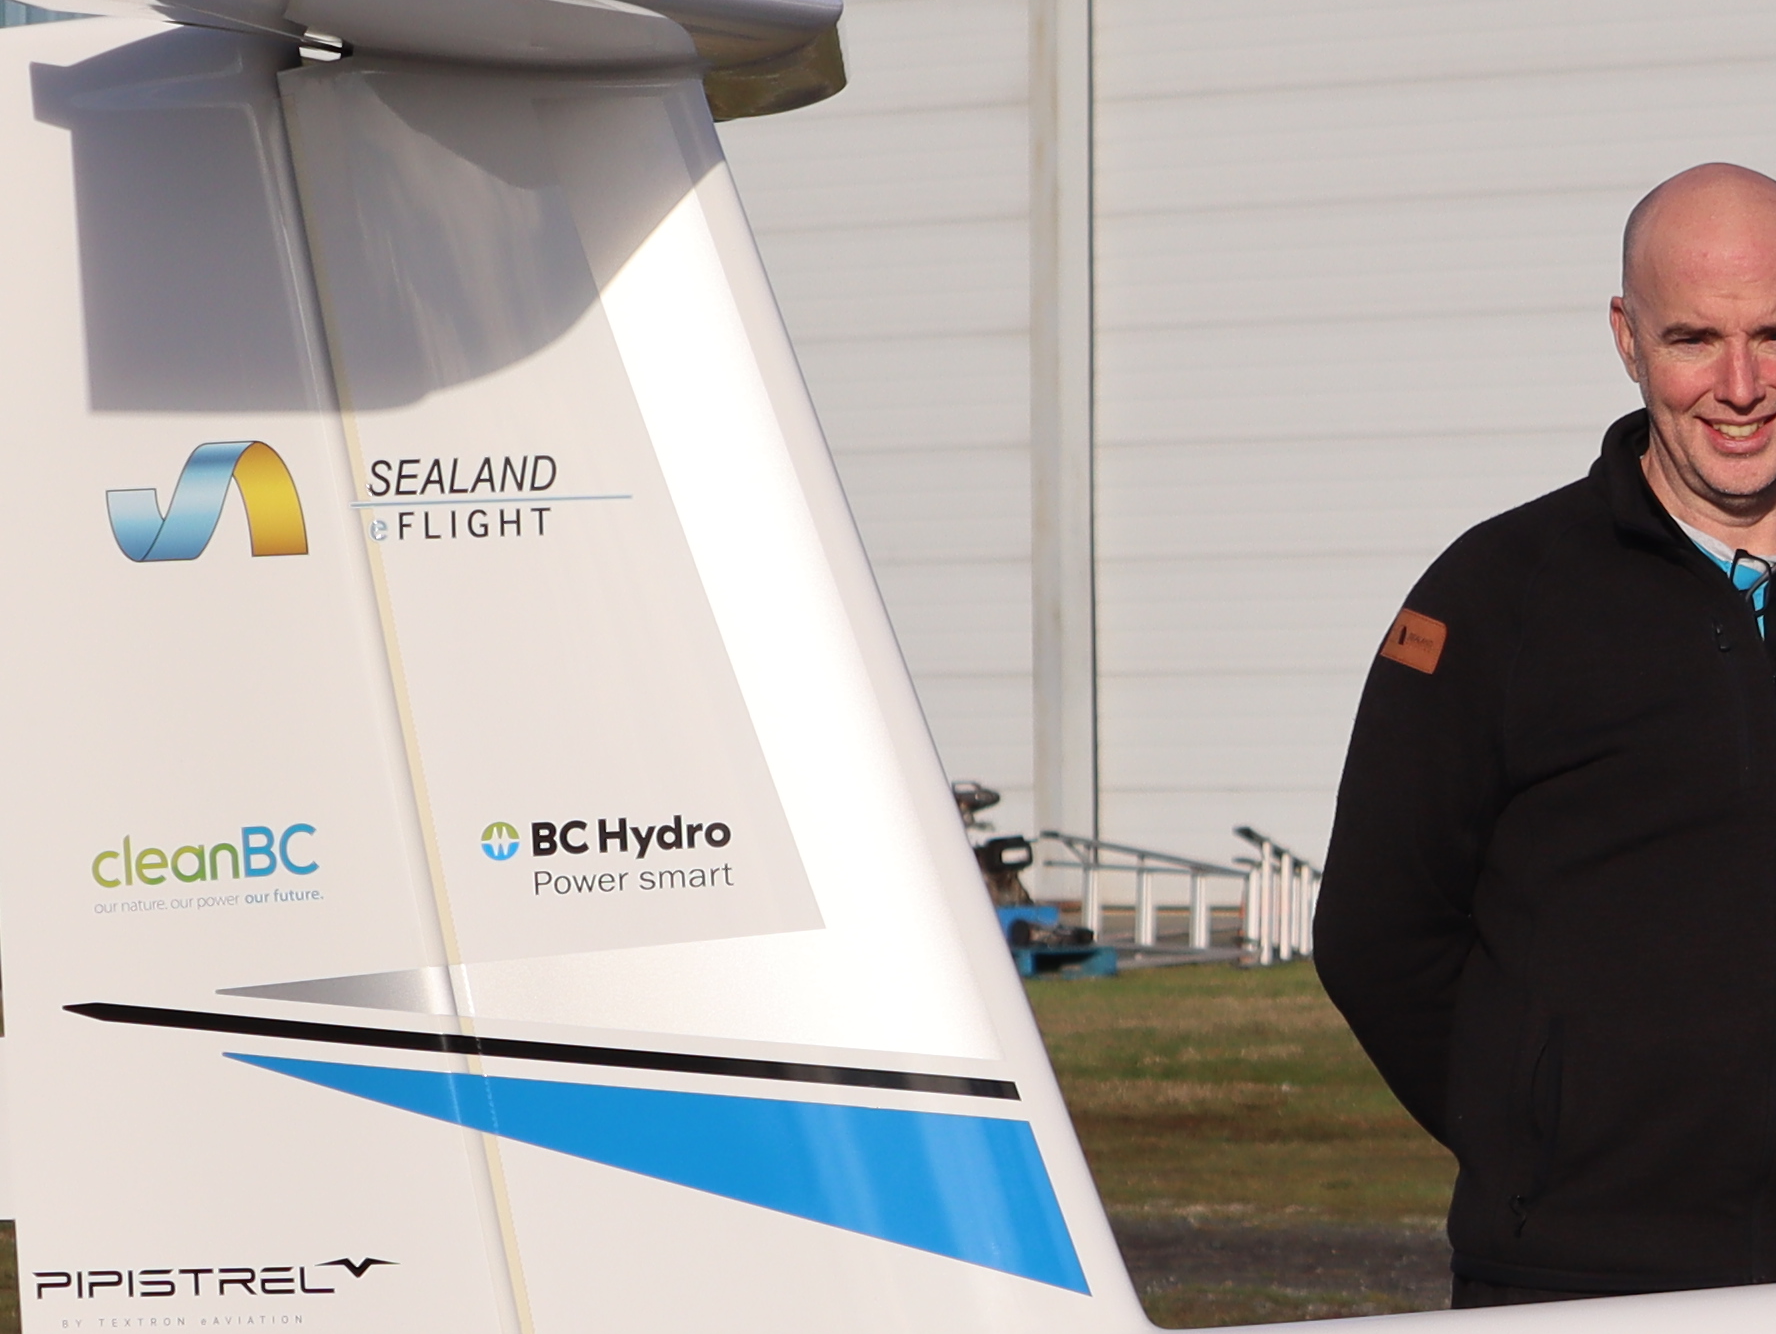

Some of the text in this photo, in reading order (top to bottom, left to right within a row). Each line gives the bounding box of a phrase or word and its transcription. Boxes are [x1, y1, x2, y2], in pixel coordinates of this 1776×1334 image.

[368, 454, 558, 498] SEALAND
[531, 814, 732, 860] BC Hydro
[91, 822, 320, 888] cleanBC
[532, 863, 735, 896] Power smart
[93, 887, 325, 915] our nature. our power our future.
[32, 1265, 336, 1300] PIPISTREL
[62, 1314, 305, 1329] BY TEXTRON eAVIATION
